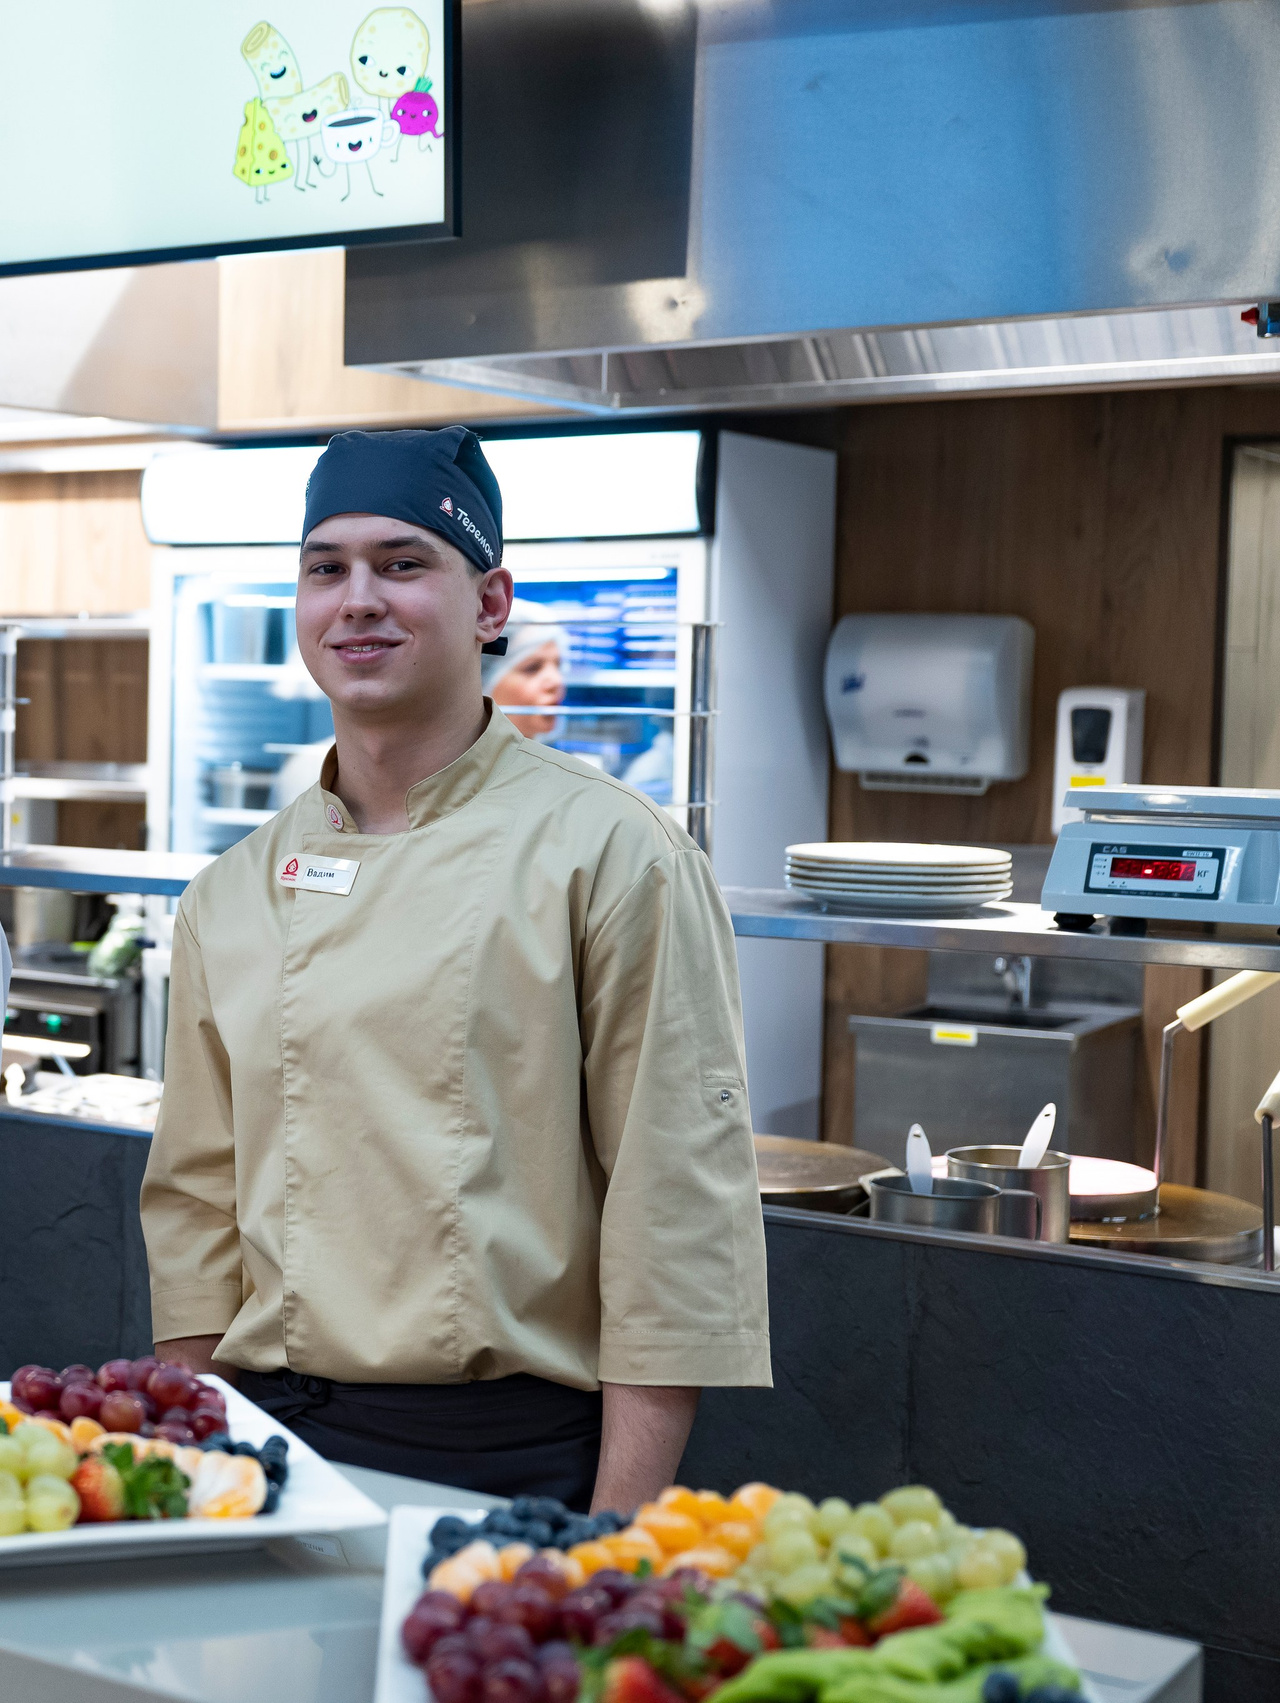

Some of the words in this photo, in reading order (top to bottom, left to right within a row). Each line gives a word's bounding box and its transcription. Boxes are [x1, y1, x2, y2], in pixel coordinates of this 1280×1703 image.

[456, 507, 494, 563] Теремок
[1102, 845, 1128, 854] CAS
[306, 868, 335, 878] Вадим
